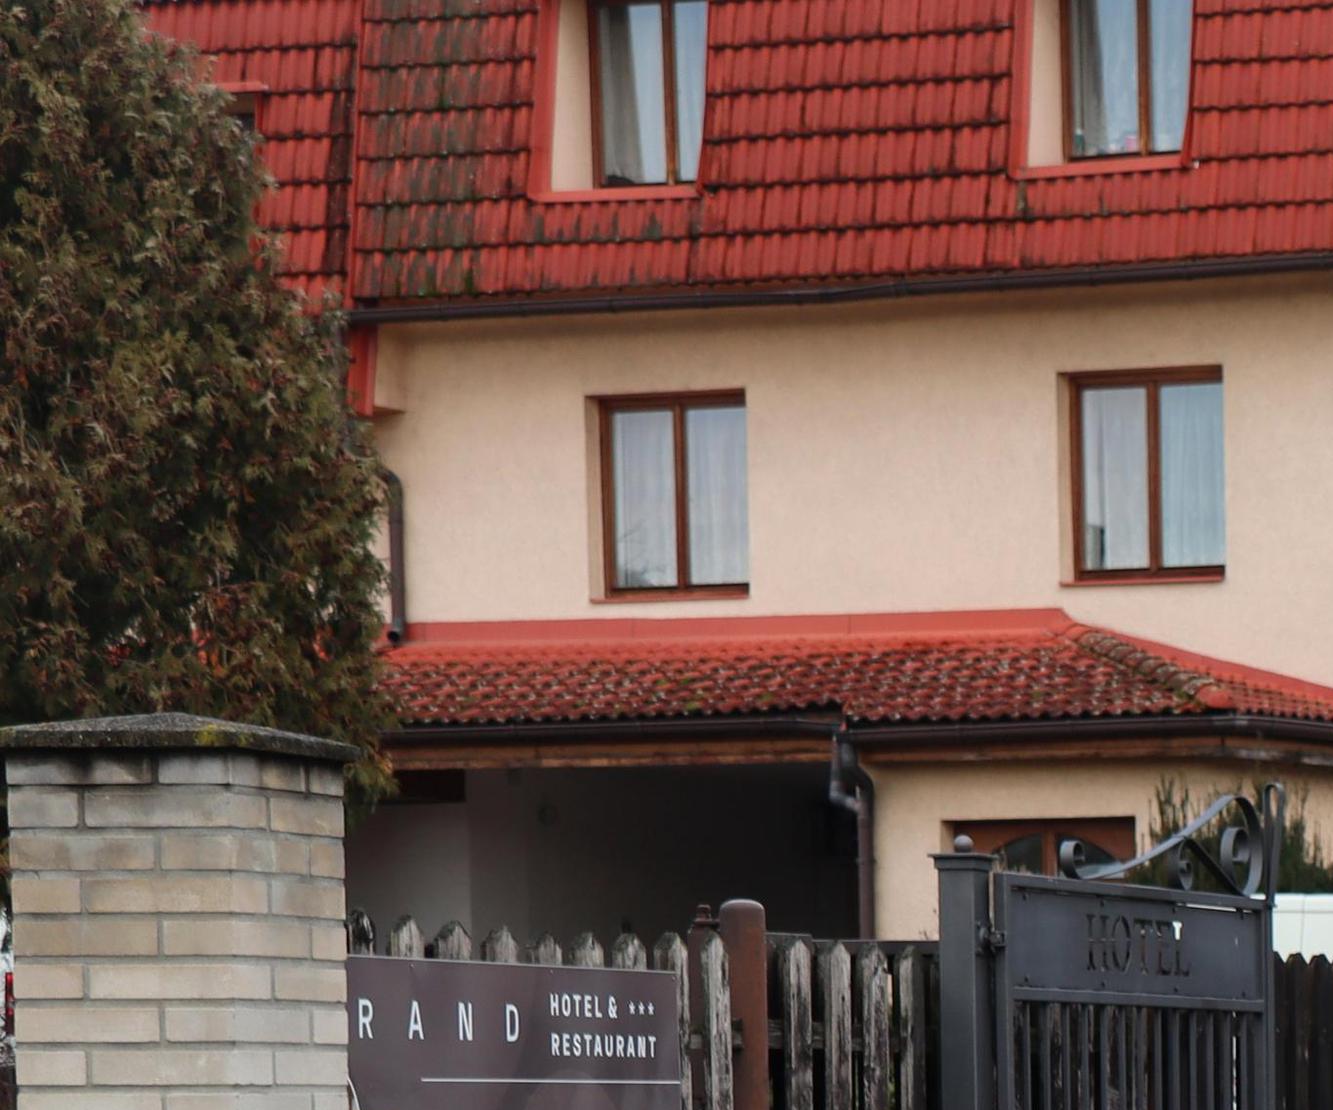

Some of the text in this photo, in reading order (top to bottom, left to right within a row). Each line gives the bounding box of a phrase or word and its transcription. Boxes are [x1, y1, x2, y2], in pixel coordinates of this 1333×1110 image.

[1085, 914, 1190, 976] HOTEL
[550, 992, 618, 1019] HOTEL &
[550, 1033, 657, 1058] RESTAURANT
